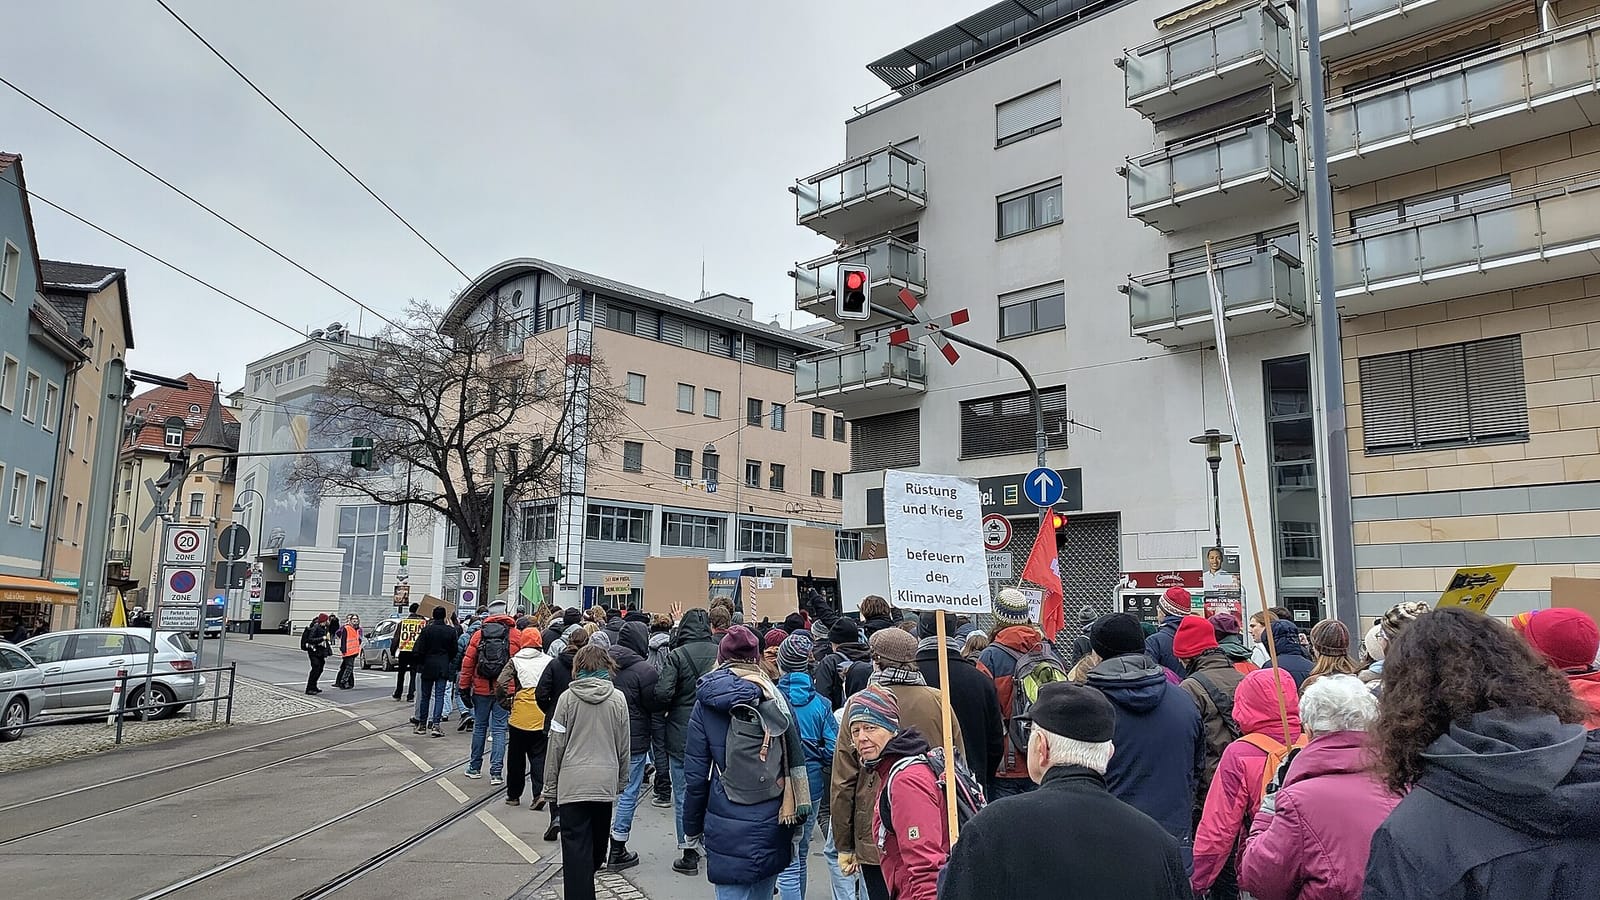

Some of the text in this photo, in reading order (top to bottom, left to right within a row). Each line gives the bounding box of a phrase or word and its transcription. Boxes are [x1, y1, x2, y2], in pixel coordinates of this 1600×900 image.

[905, 482, 957, 500] Rüstung
[903, 504, 964, 520] und Krieg
[179, 536, 194, 548] 20
[906, 548, 965, 564] befeuern
[926, 571, 949, 584] den
[897, 589, 983, 607] Klimawandel
